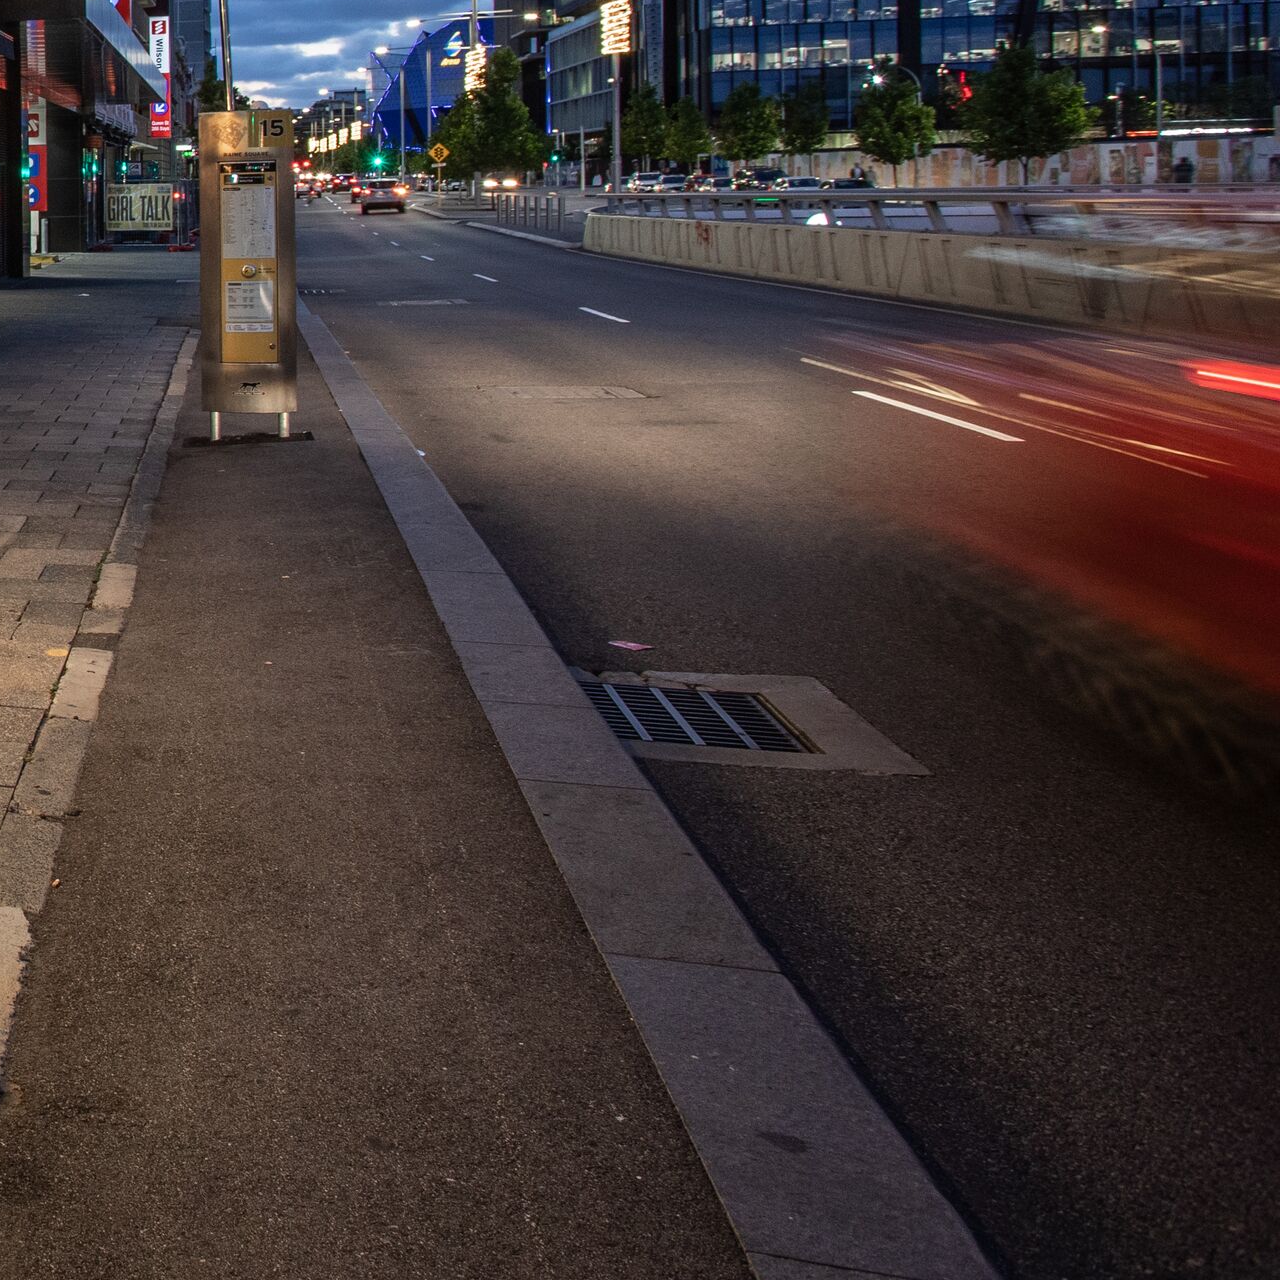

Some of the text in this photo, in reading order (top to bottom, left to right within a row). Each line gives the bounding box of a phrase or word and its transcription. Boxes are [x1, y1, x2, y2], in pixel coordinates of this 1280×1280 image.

[155, 38, 165, 70] Wilson
[259, 119, 284, 137] 15
[108, 195, 171, 221] GIRL TALK
